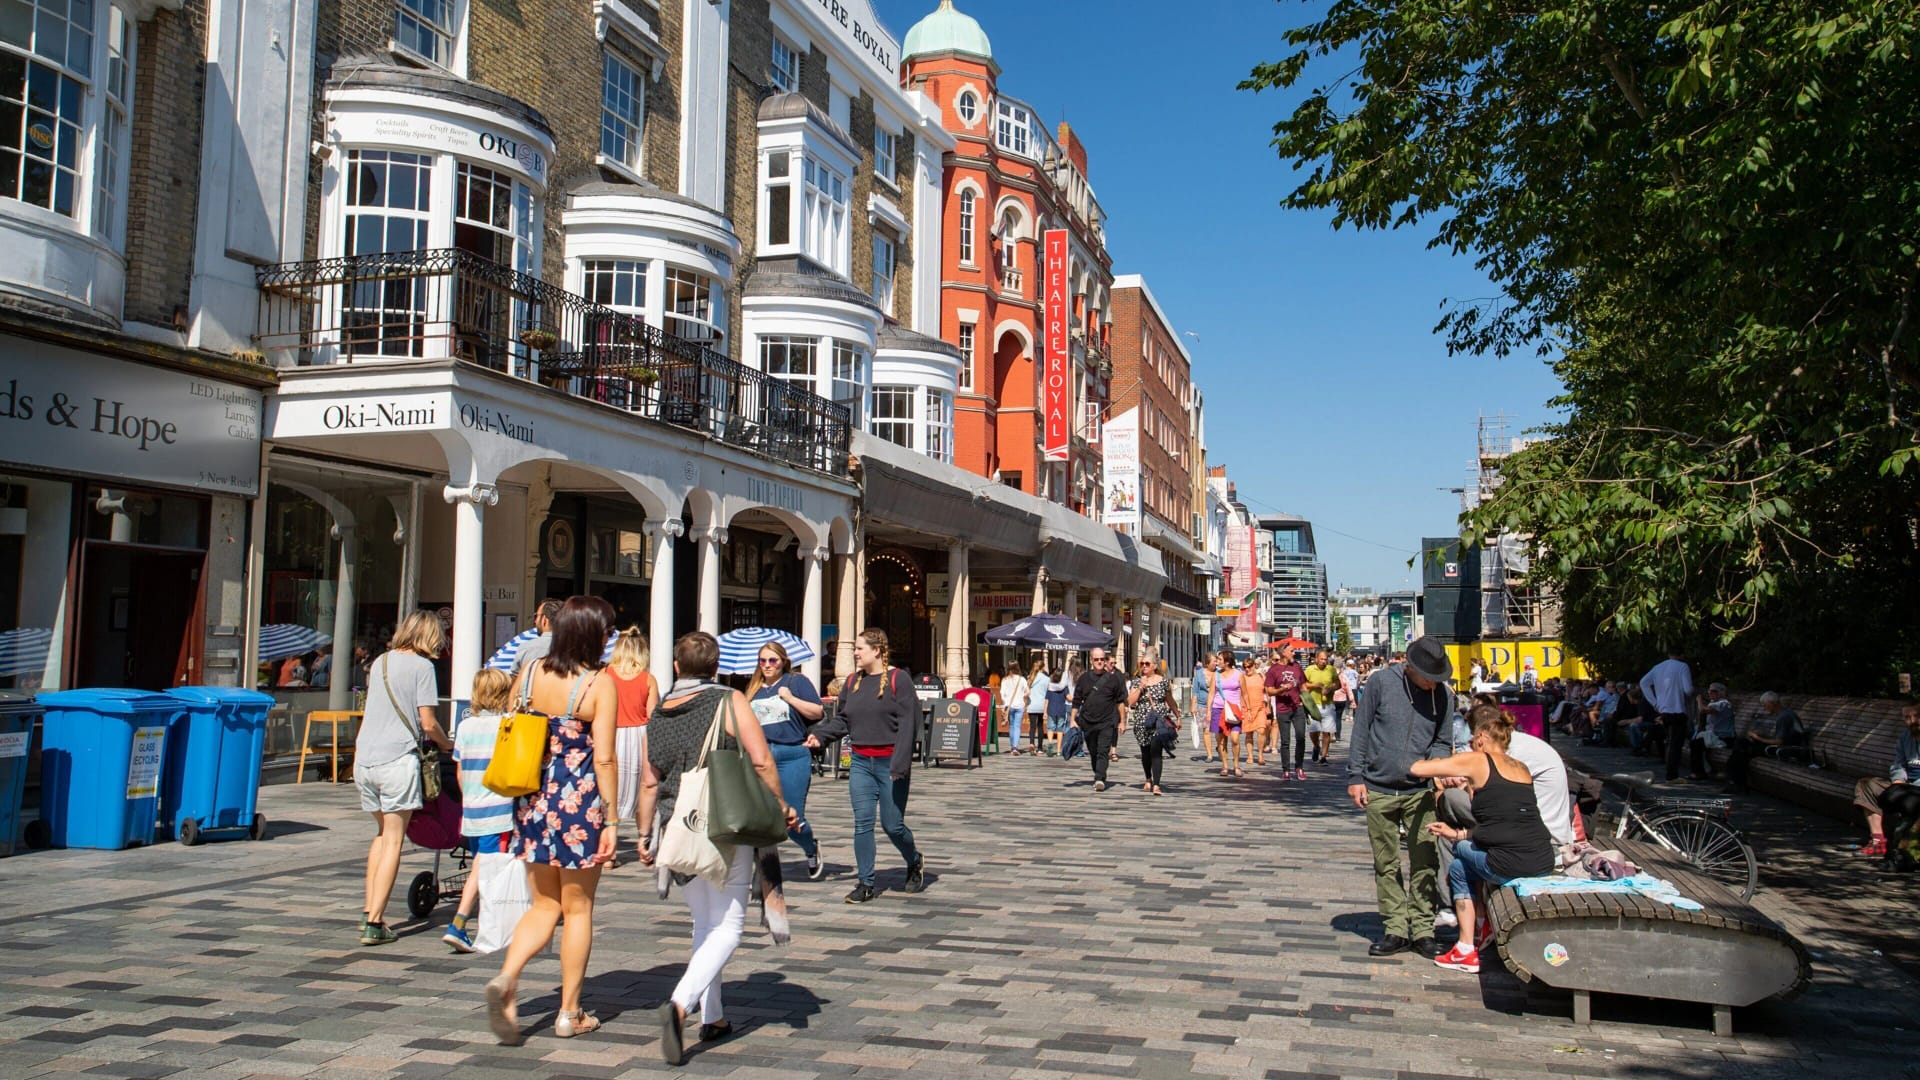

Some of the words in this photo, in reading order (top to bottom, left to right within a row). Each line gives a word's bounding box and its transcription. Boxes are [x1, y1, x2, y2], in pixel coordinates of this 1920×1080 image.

[853, 20, 894, 74] ROYAL
[376, 119, 409, 127] Cocktails
[430, 123, 448, 134] Craft
[450, 127, 468, 137] Beers
[412, 130, 436, 140] Spirits
[448, 136, 468, 146] Tapas
[479, 133, 517, 160] OKI
[1050, 240, 1062, 350] THEATRE
[189, 382, 214, 398] LED
[216, 388, 257, 410] Lighting
[1050, 359, 1062, 437] ROYAL
[46, 392, 79, 430] &
[90, 397, 177, 451] Hope
[225, 407, 256, 426] Lamps
[323, 400, 435, 430] Oki-Nami
[460, 403, 534, 444] Oki-Nami
[228, 424, 255, 441] Cable
[199, 471, 204, 481] 5
[207, 472, 228, 485] New
[230, 475, 252, 489] Road
[498, 587, 517, 599] Bar
[973, 595, 992, 608] ALAN
[1045, 643, 1080, 651] FEVER-TREE
[1490, 647, 1511, 666] D
[1541, 646, 1564, 667] D
[139, 743, 155, 753] GLASS
